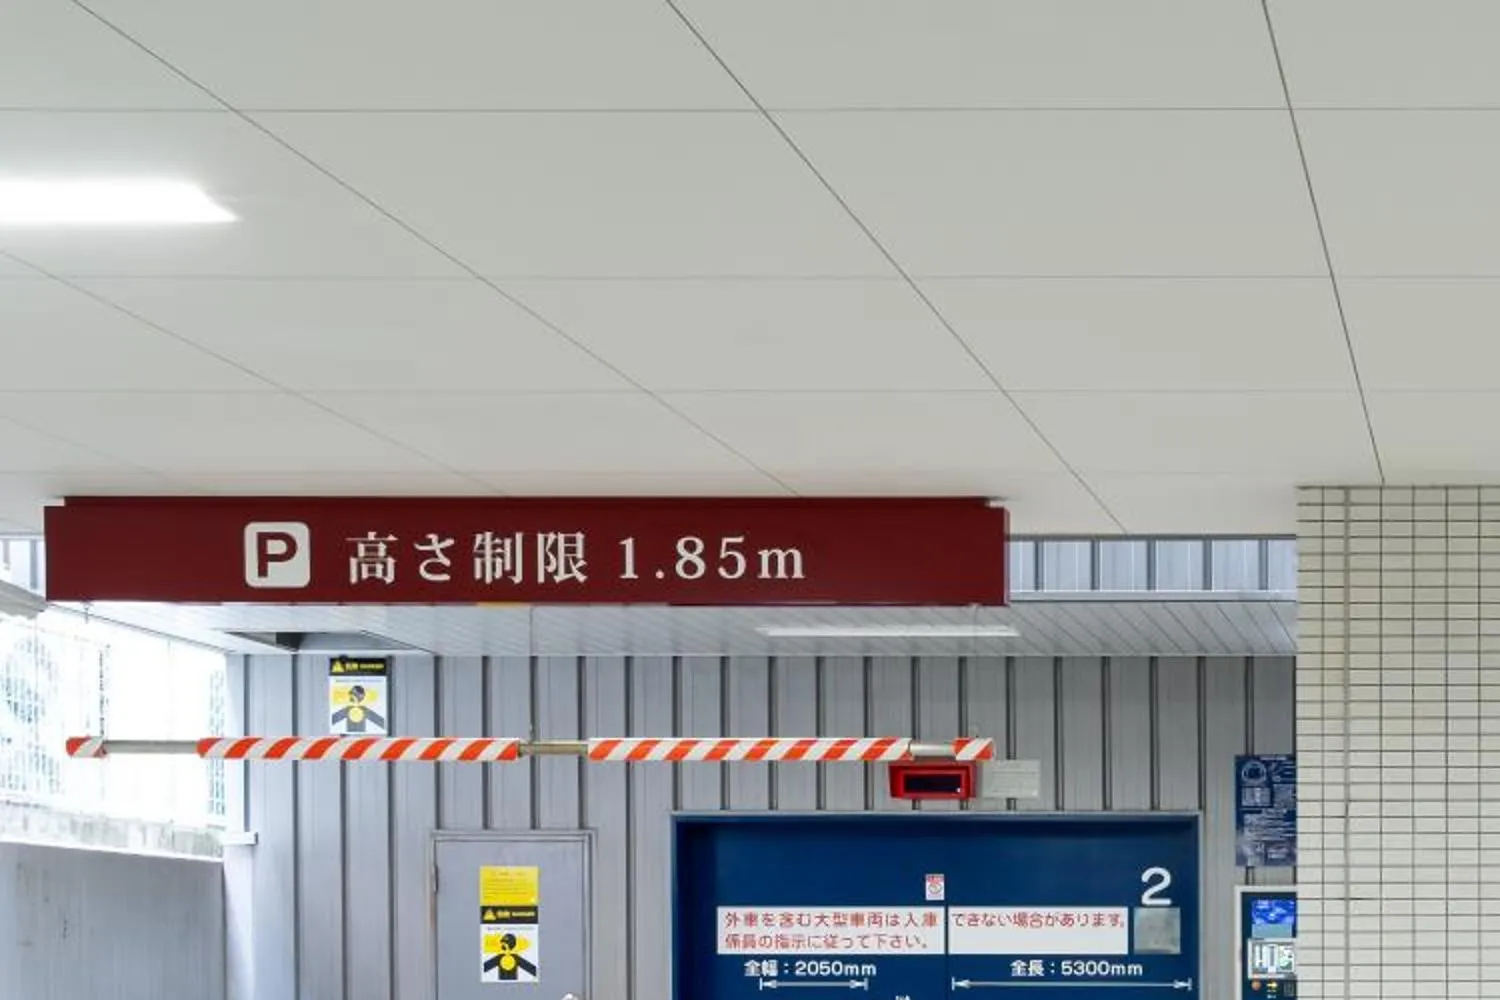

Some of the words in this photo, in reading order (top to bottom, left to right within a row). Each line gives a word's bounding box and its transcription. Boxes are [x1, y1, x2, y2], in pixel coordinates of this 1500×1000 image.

[257, 531, 297, 578] P
[346, 530, 588, 586] 高さ制限
[620, 536, 806, 581] 1.85m
[1141, 866, 1172, 906] 2
